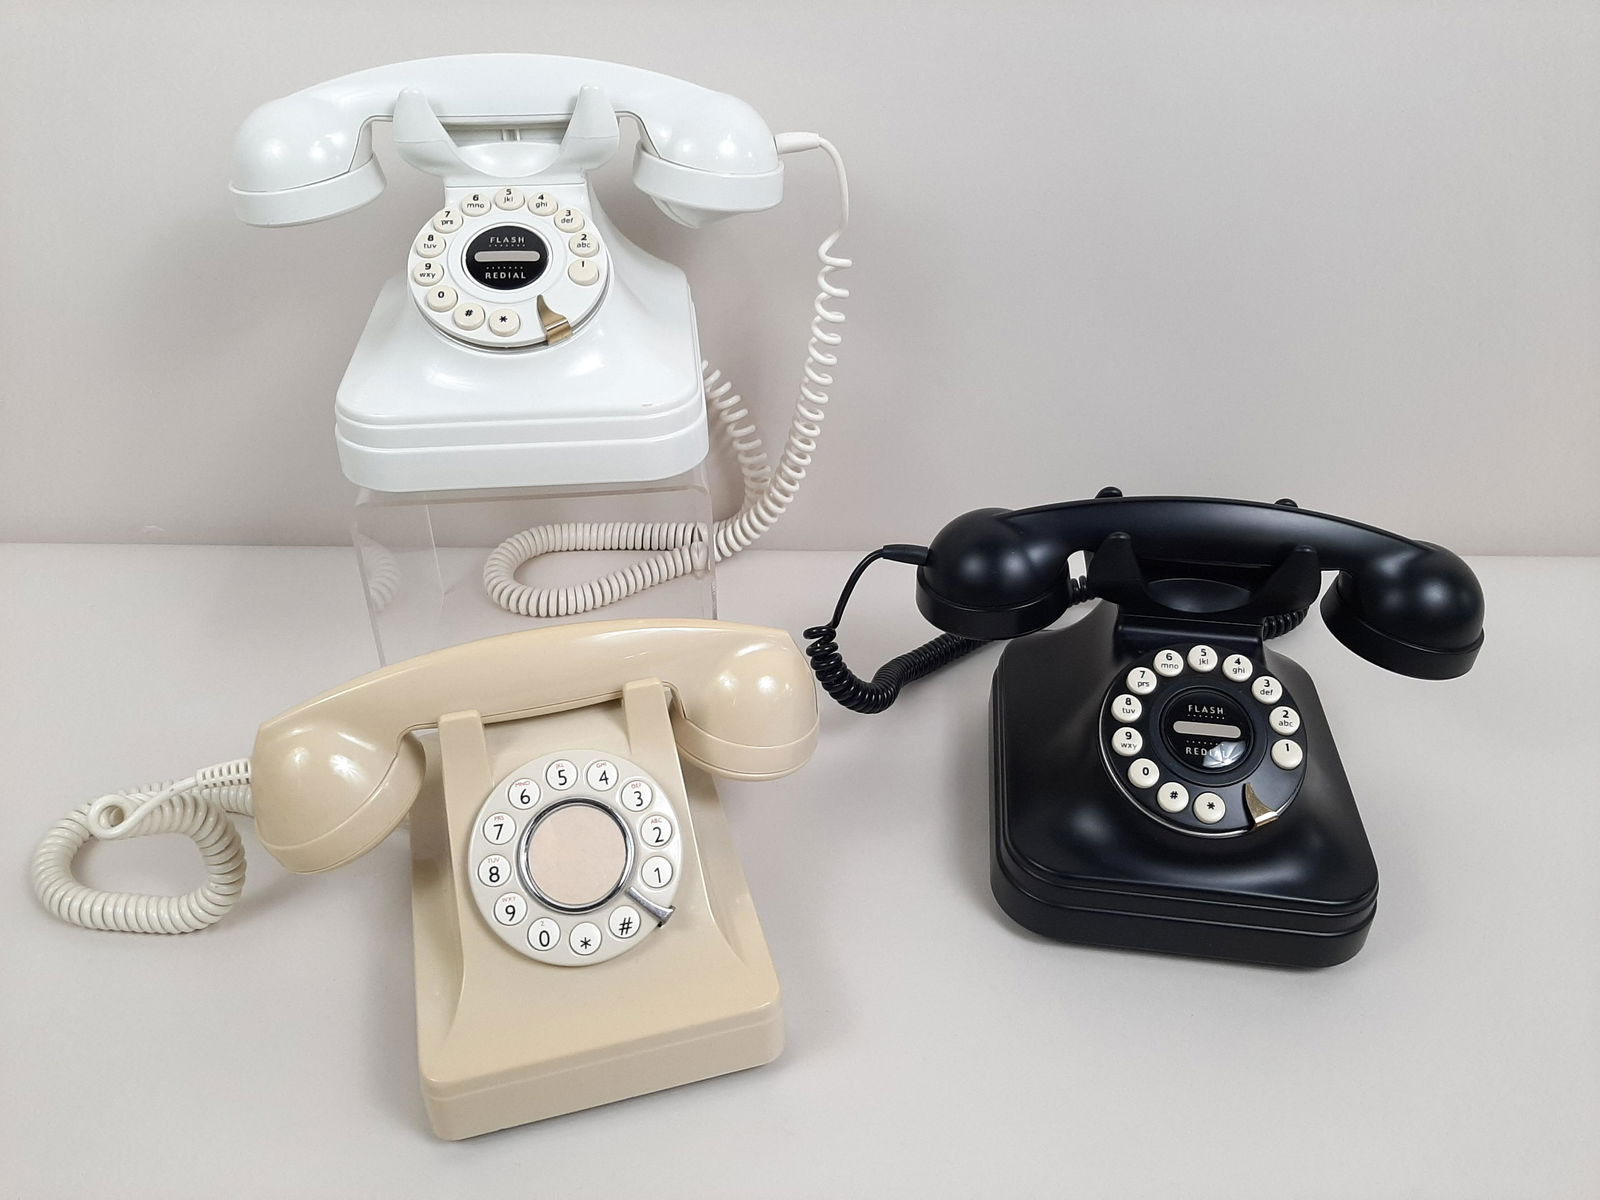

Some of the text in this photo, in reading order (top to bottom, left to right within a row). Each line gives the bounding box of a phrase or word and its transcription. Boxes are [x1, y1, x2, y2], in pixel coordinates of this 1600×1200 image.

[465, 309, 473, 317] #
[1166, 653, 1173, 661] 6
[1200, 648, 1207, 656] 5
[1232, 666, 1245, 674] ghi
[1264, 679, 1270, 687] 3
[1188, 704, 1224, 715] FLASH
[1282, 710, 1289, 718] 2
[1125, 731, 1132, 740] 9
[558, 769, 567, 786] 5
[599, 770, 609, 785] 4
[1142, 767, 1149, 776] 0
[520, 788, 531, 805] 6
[633, 790, 643, 807] 3
[1169, 790, 1178, 799] #
[493, 823, 504, 840] 7
[652, 826, 664, 843] 2
[489, 866, 500, 882] 8
[654, 867, 661, 883] 1
[505, 904, 516, 921] 9
[619, 916, 633, 935] #
[539, 930, 550, 947] 0
